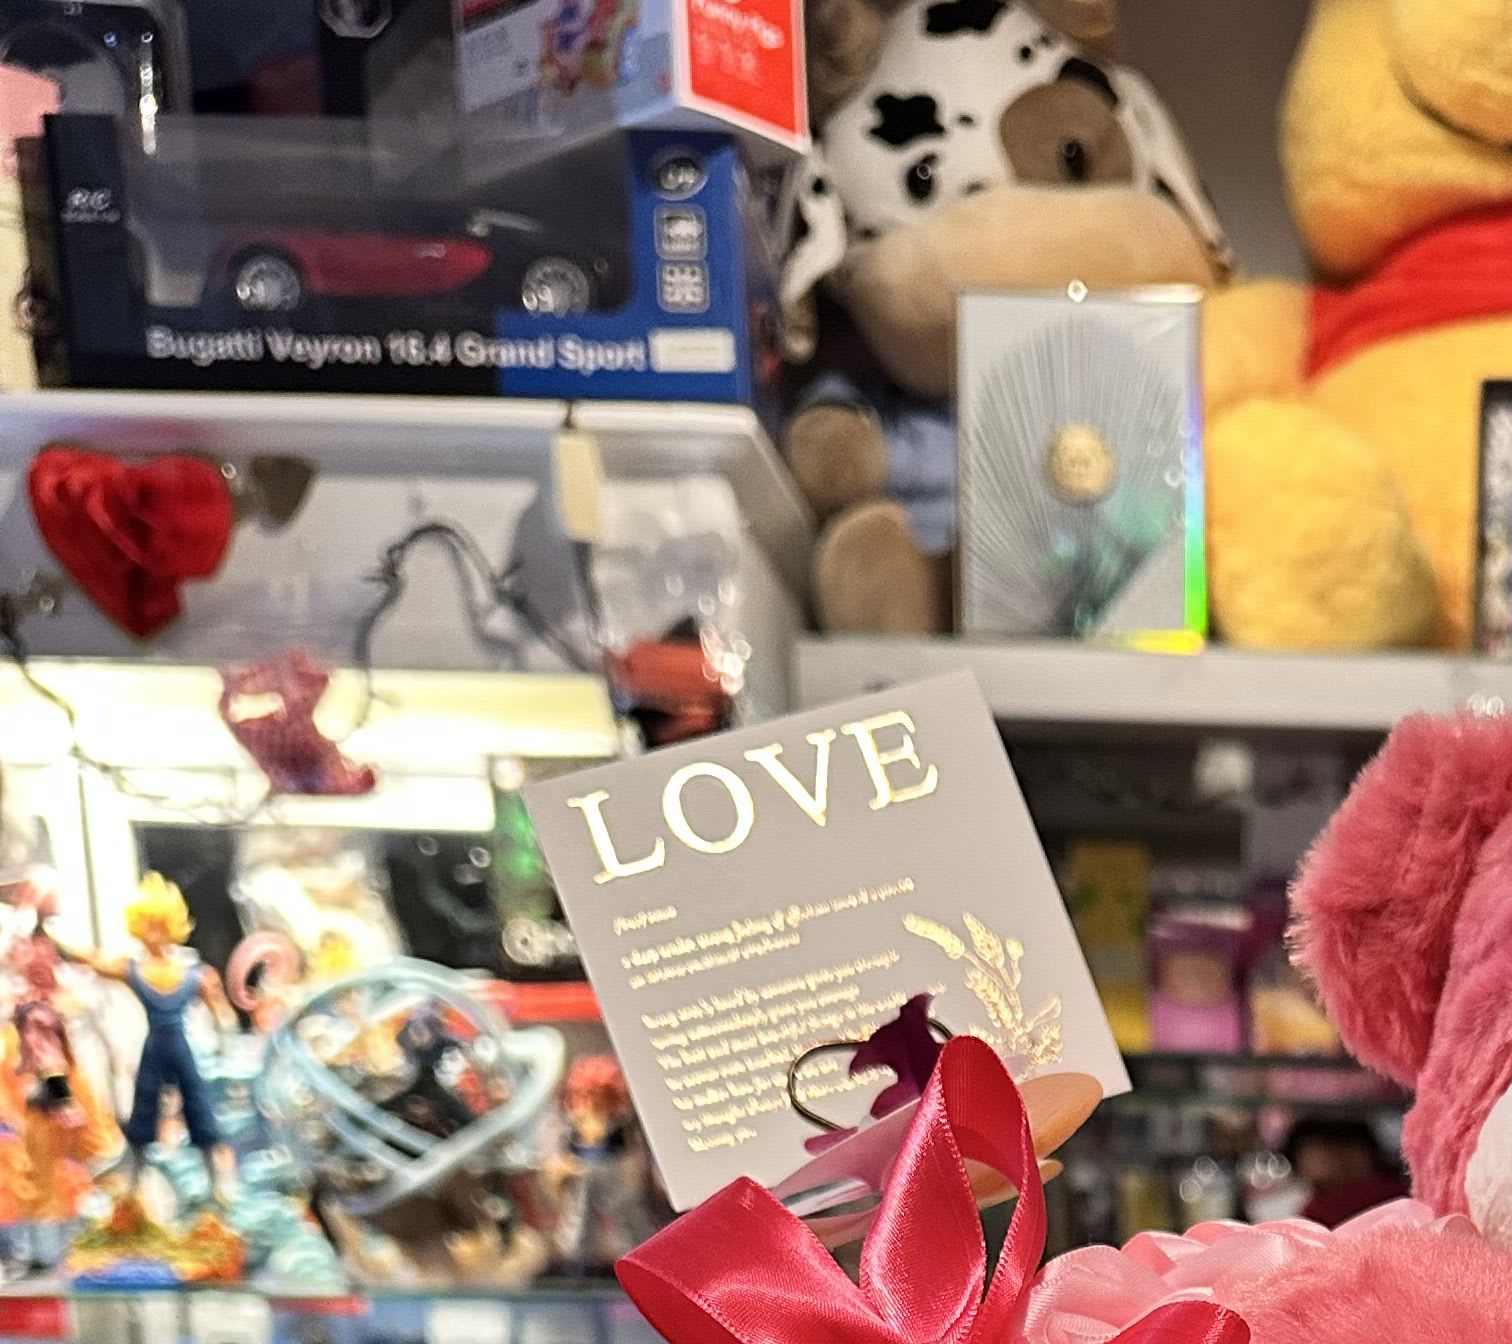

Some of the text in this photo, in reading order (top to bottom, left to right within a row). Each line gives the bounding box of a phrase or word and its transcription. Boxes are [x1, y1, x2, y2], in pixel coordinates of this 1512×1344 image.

[146, 325, 264, 367] Bugatti
[264, 327, 382, 370] Veyron
[454, 330, 555, 368] Grand
[557, 332, 648, 376] Sport
[565, 709, 939, 885] LOVE
